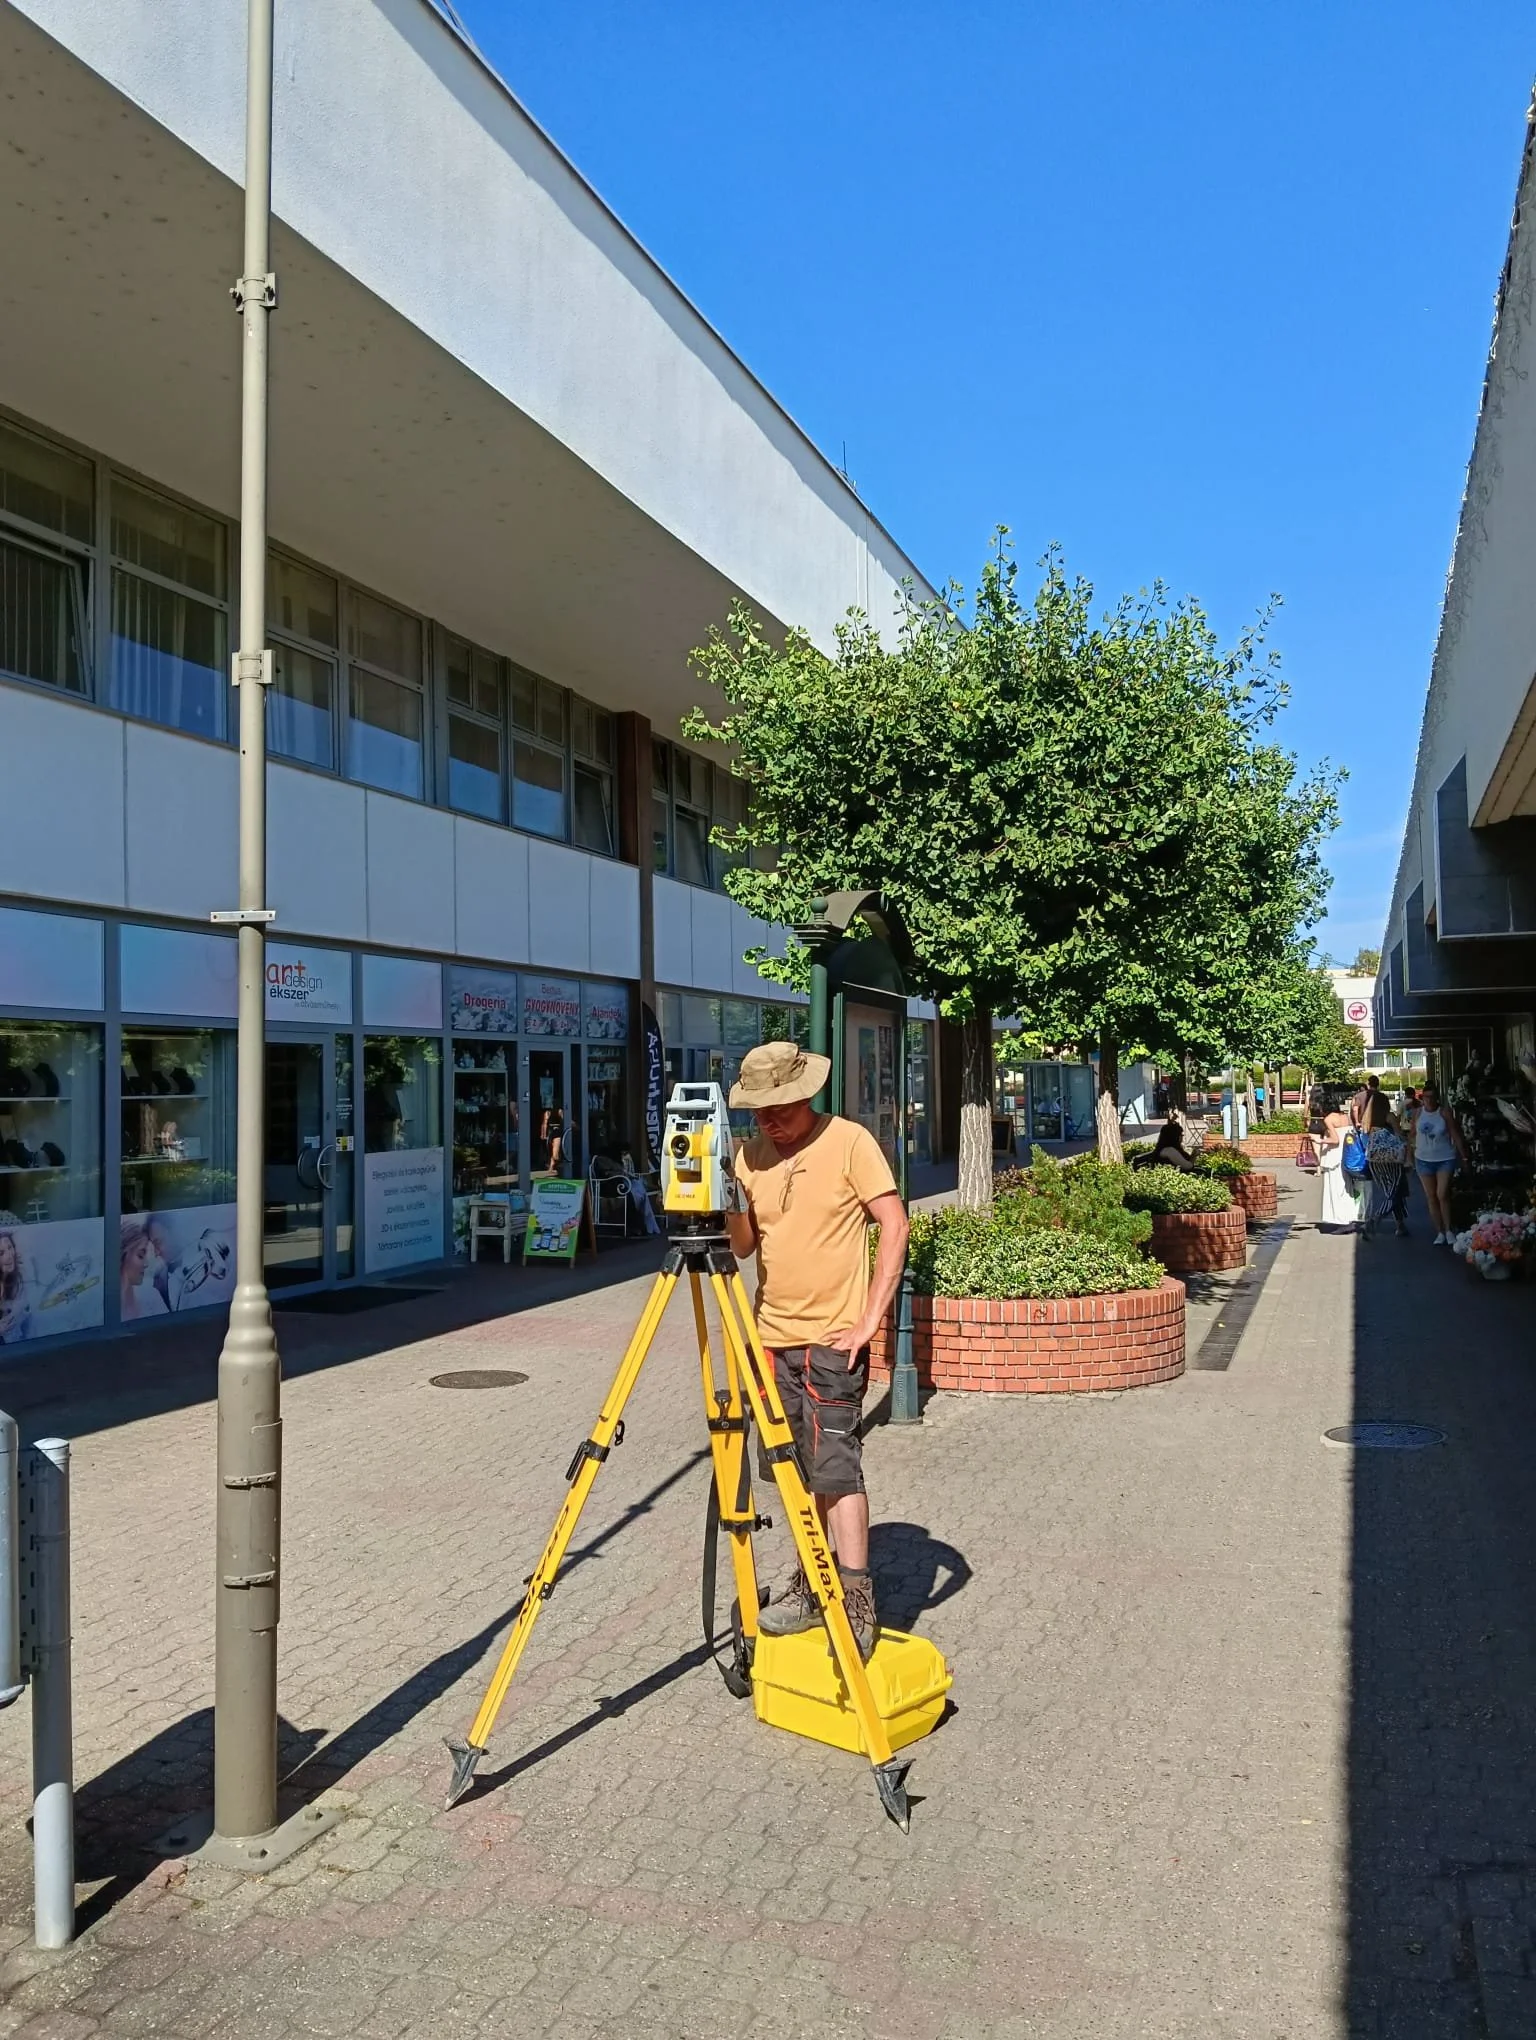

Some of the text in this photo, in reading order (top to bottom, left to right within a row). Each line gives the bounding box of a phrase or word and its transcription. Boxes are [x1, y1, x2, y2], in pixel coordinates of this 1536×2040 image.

[267, 960, 322, 992] art design
[270, 985, 309, 1000] ékszer
[464, 992, 505, 1011] Drogeria
[797, 1507, 838, 1602] Tri-Max
